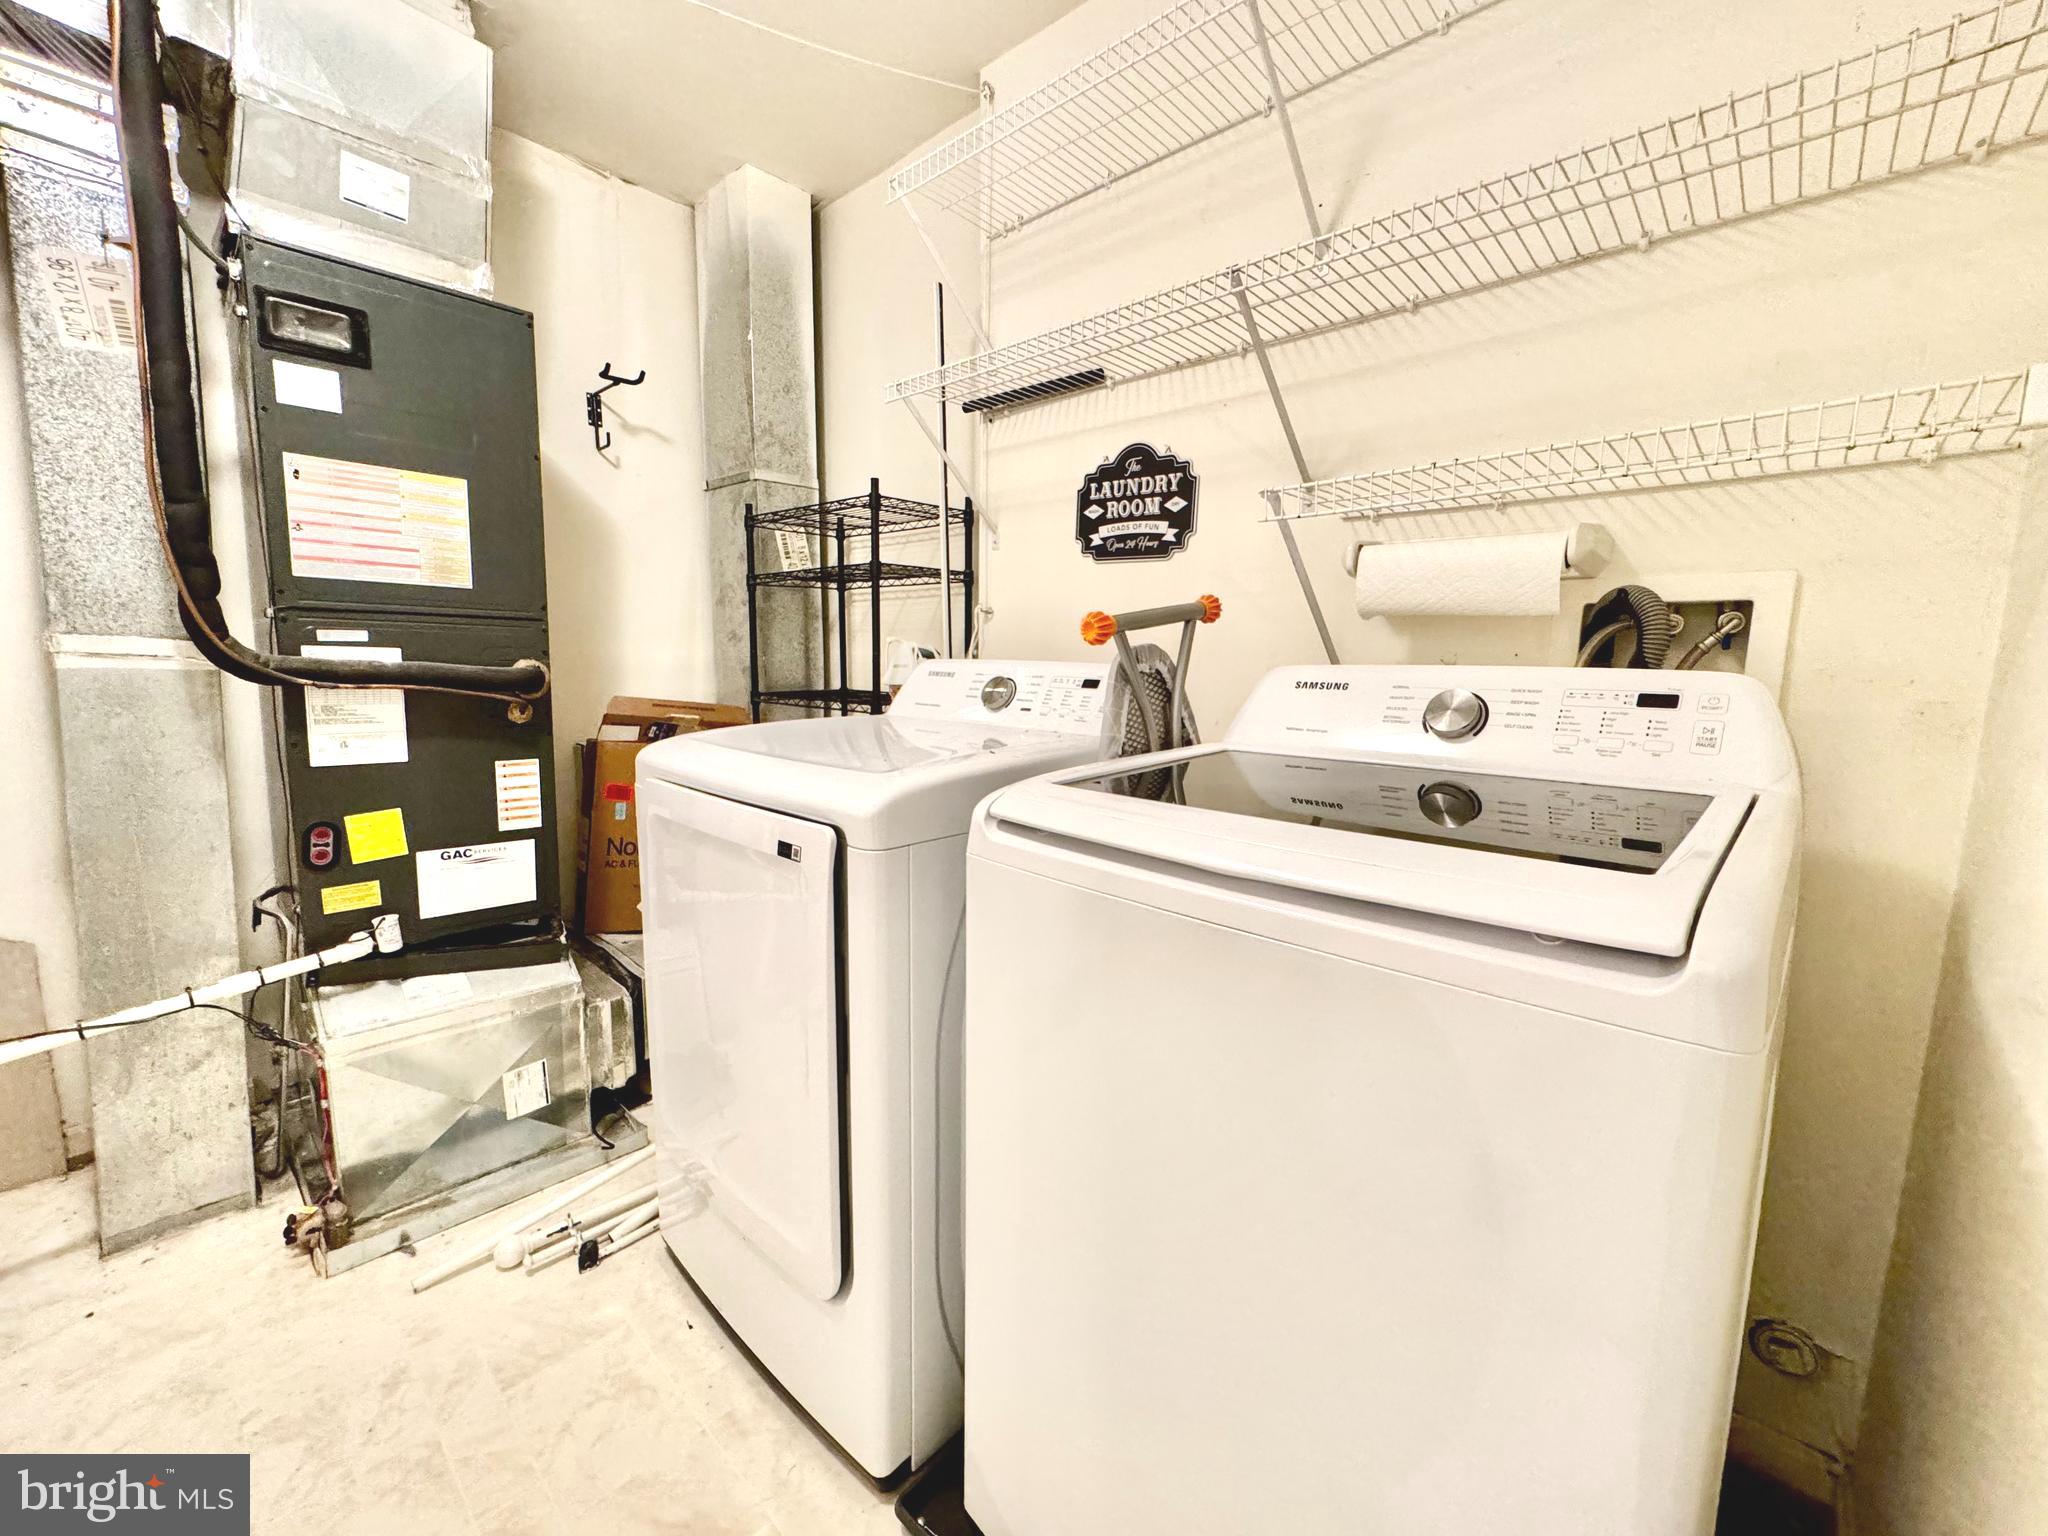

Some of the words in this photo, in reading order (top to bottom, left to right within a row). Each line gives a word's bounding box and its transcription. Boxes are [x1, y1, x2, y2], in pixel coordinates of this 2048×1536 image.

[46, 256, 75, 273] 96
[53, 281, 80, 294] 12
[87, 276, 121, 292] 40
[59, 305, 85, 314] 8
[1124, 456, 1143, 477] The
[1089, 472, 1184, 501] LAUNDRY
[1105, 496, 1163, 519] ROOM
[1106, 524, 1131, 534] LOADS
[1132, 523, 1143, 531] OF
[1144, 522, 1160, 531] FUN
[1105, 538, 1124, 552] Open
[1124, 539, 1137, 549] 24
[1136, 535, 1160, 552] Hours
[1294, 680, 1350, 691] SAMSUNG
[440, 848, 473, 861] GAC
[606, 836, 639, 857] No
[604, 859, 618, 869] AC
[619, 859, 627, 869] &
